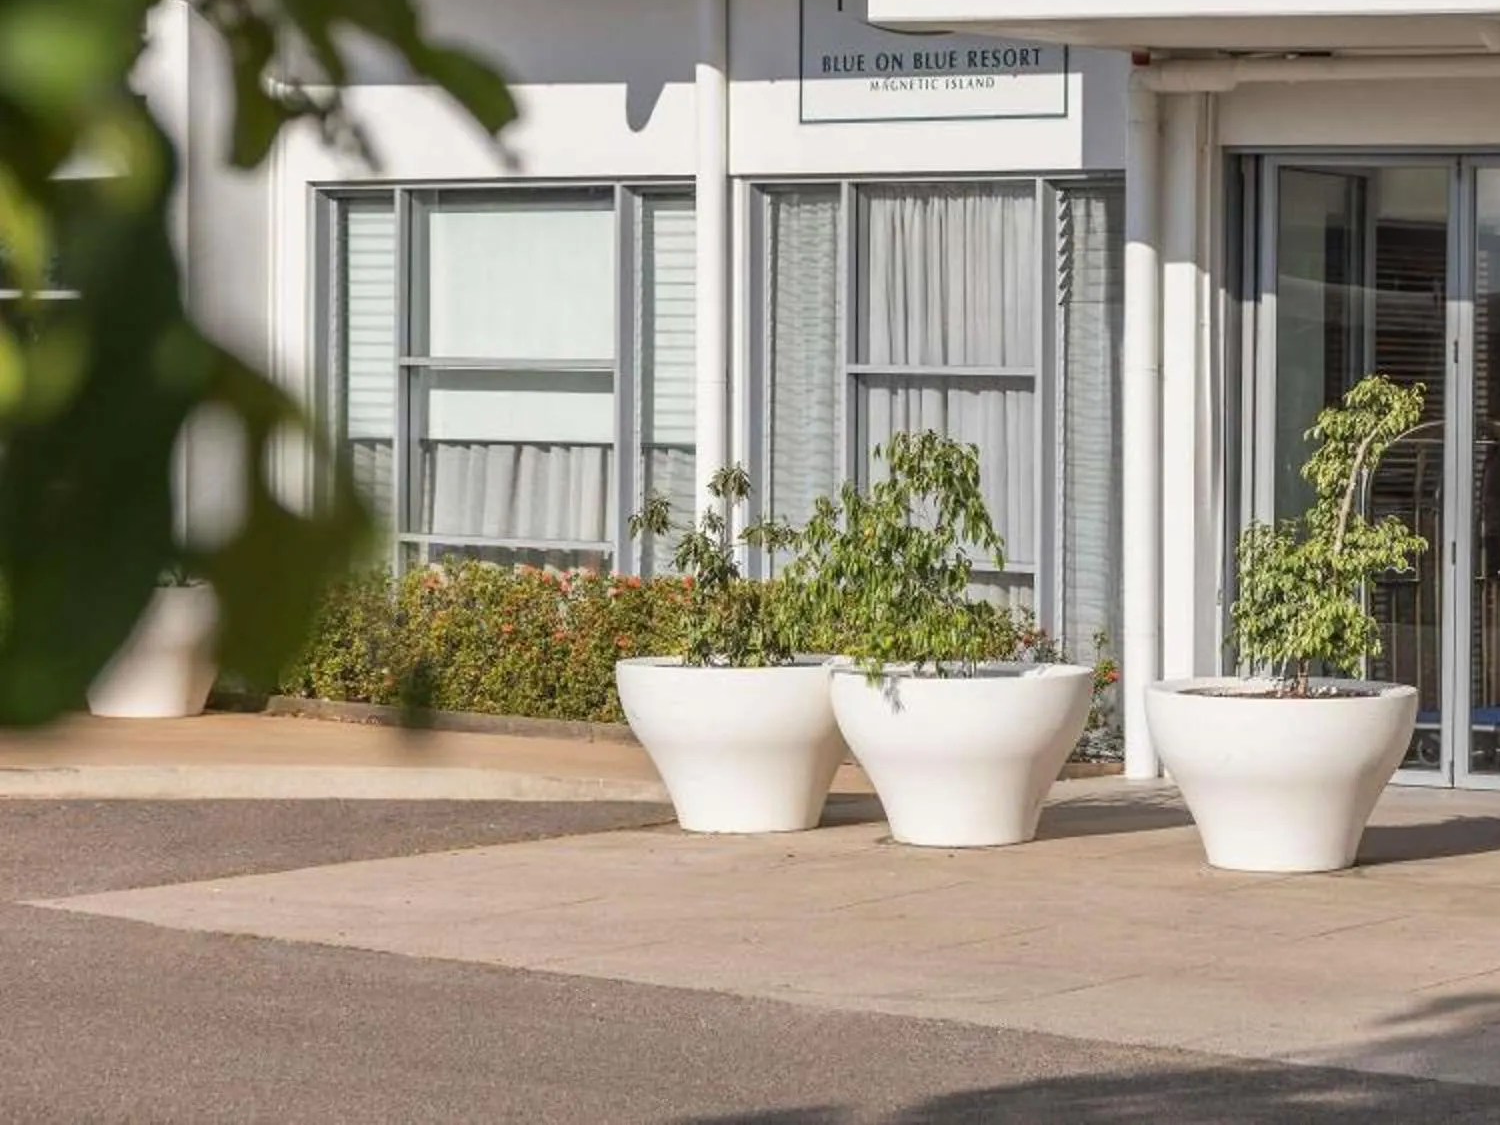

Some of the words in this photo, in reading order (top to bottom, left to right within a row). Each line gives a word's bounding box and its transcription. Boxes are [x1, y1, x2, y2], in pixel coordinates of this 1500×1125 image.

[821, 53, 866, 73] BLUE
[875, 52, 904, 72] ON
[913, 50, 958, 70] BLUE
[967, 48, 1041, 68] RESORT
[869, 77, 938, 92] MAGNETIC
[944, 76, 996, 90] ISLAND
